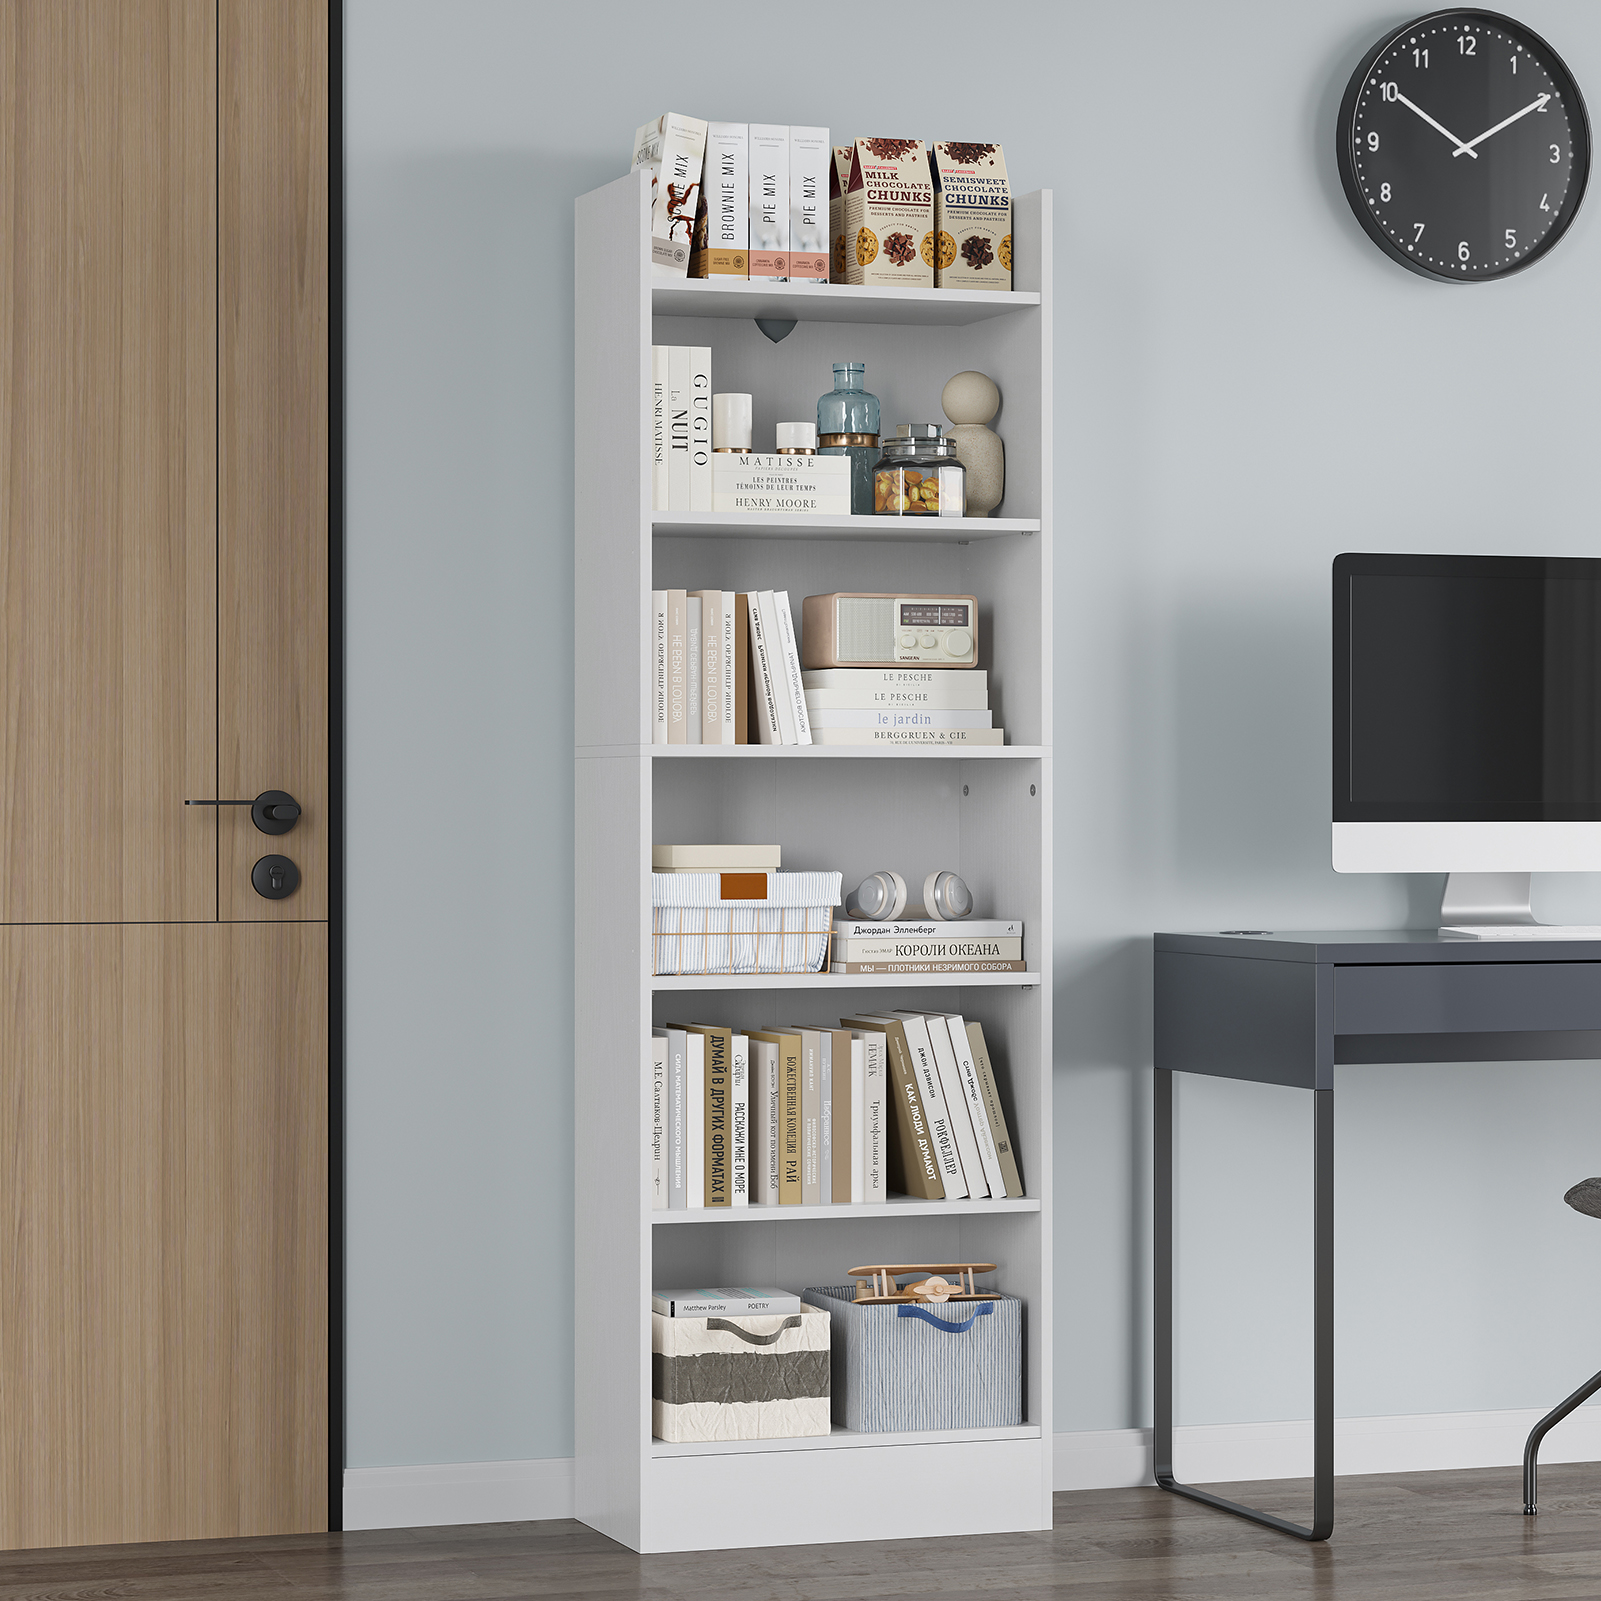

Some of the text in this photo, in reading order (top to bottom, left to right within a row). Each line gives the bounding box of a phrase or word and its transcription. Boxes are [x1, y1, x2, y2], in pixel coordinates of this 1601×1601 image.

[1456, 35, 1476, 56] 12
[1412, 48, 1429, 69] 11
[1510, 55, 1517, 74] 1
[1379, 81, 1398, 102] 10
[1537, 92, 1549, 112] 2
[1367, 131, 1379, 152] 9
[1549, 144, 1561, 164] 3
[674, 154, 689, 178] MIX
[865, 171, 899, 180] MILK
[866, 181, 931, 190] CHOCOLATE
[943, 176, 1006, 185] SEMISWEET
[945, 185, 1008, 194] CHOCOLATE
[722, 153, 734, 240] BROWNIE MIX
[763, 174, 776, 223] PIE MIX
[803, 176, 816, 224] PIE MIX
[867, 190, 931, 203] CHUNKS
[946, 193, 1009, 206] CHUNKS
[1380, 182, 1391, 202] 8
[1539, 193, 1550, 212] 4
[1413, 223, 1425, 243] 7
[1505, 229, 1517, 249] 5
[1458, 241, 1470, 261] 6
[654, 383, 663, 466] HENRI MATISSE
[671, 391, 688, 452] La NUIT
[693, 374, 708, 466] GUGIO
[739, 456, 814, 468] MATISSE
[736, 482, 764, 490] TÉMOINS
[735, 498, 817, 508] HENRY MOORE
[883, 673, 933, 682] LE PESCHE
[874, 693, 928, 701] LE PESCHE
[878, 713, 931, 727] le jardin
[874, 731, 935, 739] BERGGRUEN
[854, 925, 936, 936] Джордан Элленберг
[895, 943, 1000, 957] КОРОЛИ ОКЕАНА
[888, 964, 930, 972] ПЛОТНИКИ
[932, 963, 979, 971] НЕЗРИМОГО
[981, 962, 1012, 971] СОБОРА
[710, 1035, 728, 1074] ДУМАЙ
[868, 1044, 877, 1077] РЕМАРК
[917, 1047, 935, 1099] ДЖОН ДЭВИСОН
[652, 1061, 663, 1161] М.Е. Салтыков-Щедрин
[710, 1087, 724, 1131] ДРУГИХ
[770, 1091, 778, 1124] Уличный
[734, 1102, 745, 1144] РАССКАЖИ
[785, 1056, 800, 1183] БОЖЕСТВЕННАЯ КОМЕДИЯ РАЙ
[821, 1100, 831, 1146] Избранное
[904, 1083, 936, 1181] КАК ЛЮДИ ДУМАЮТ
[734, 1146, 745, 1162] МНЕ
[770, 1139, 776, 1150] по
[869, 1100, 881, 1189] Триумфальная арка
[934, 1119, 958, 1175] РОКФЕЛЛЕР
[711, 1134, 724, 1193] ФОРМАТАХ
[734, 1172, 745, 1194] МОРЕ
[770, 1174, 779, 1189] Боб
